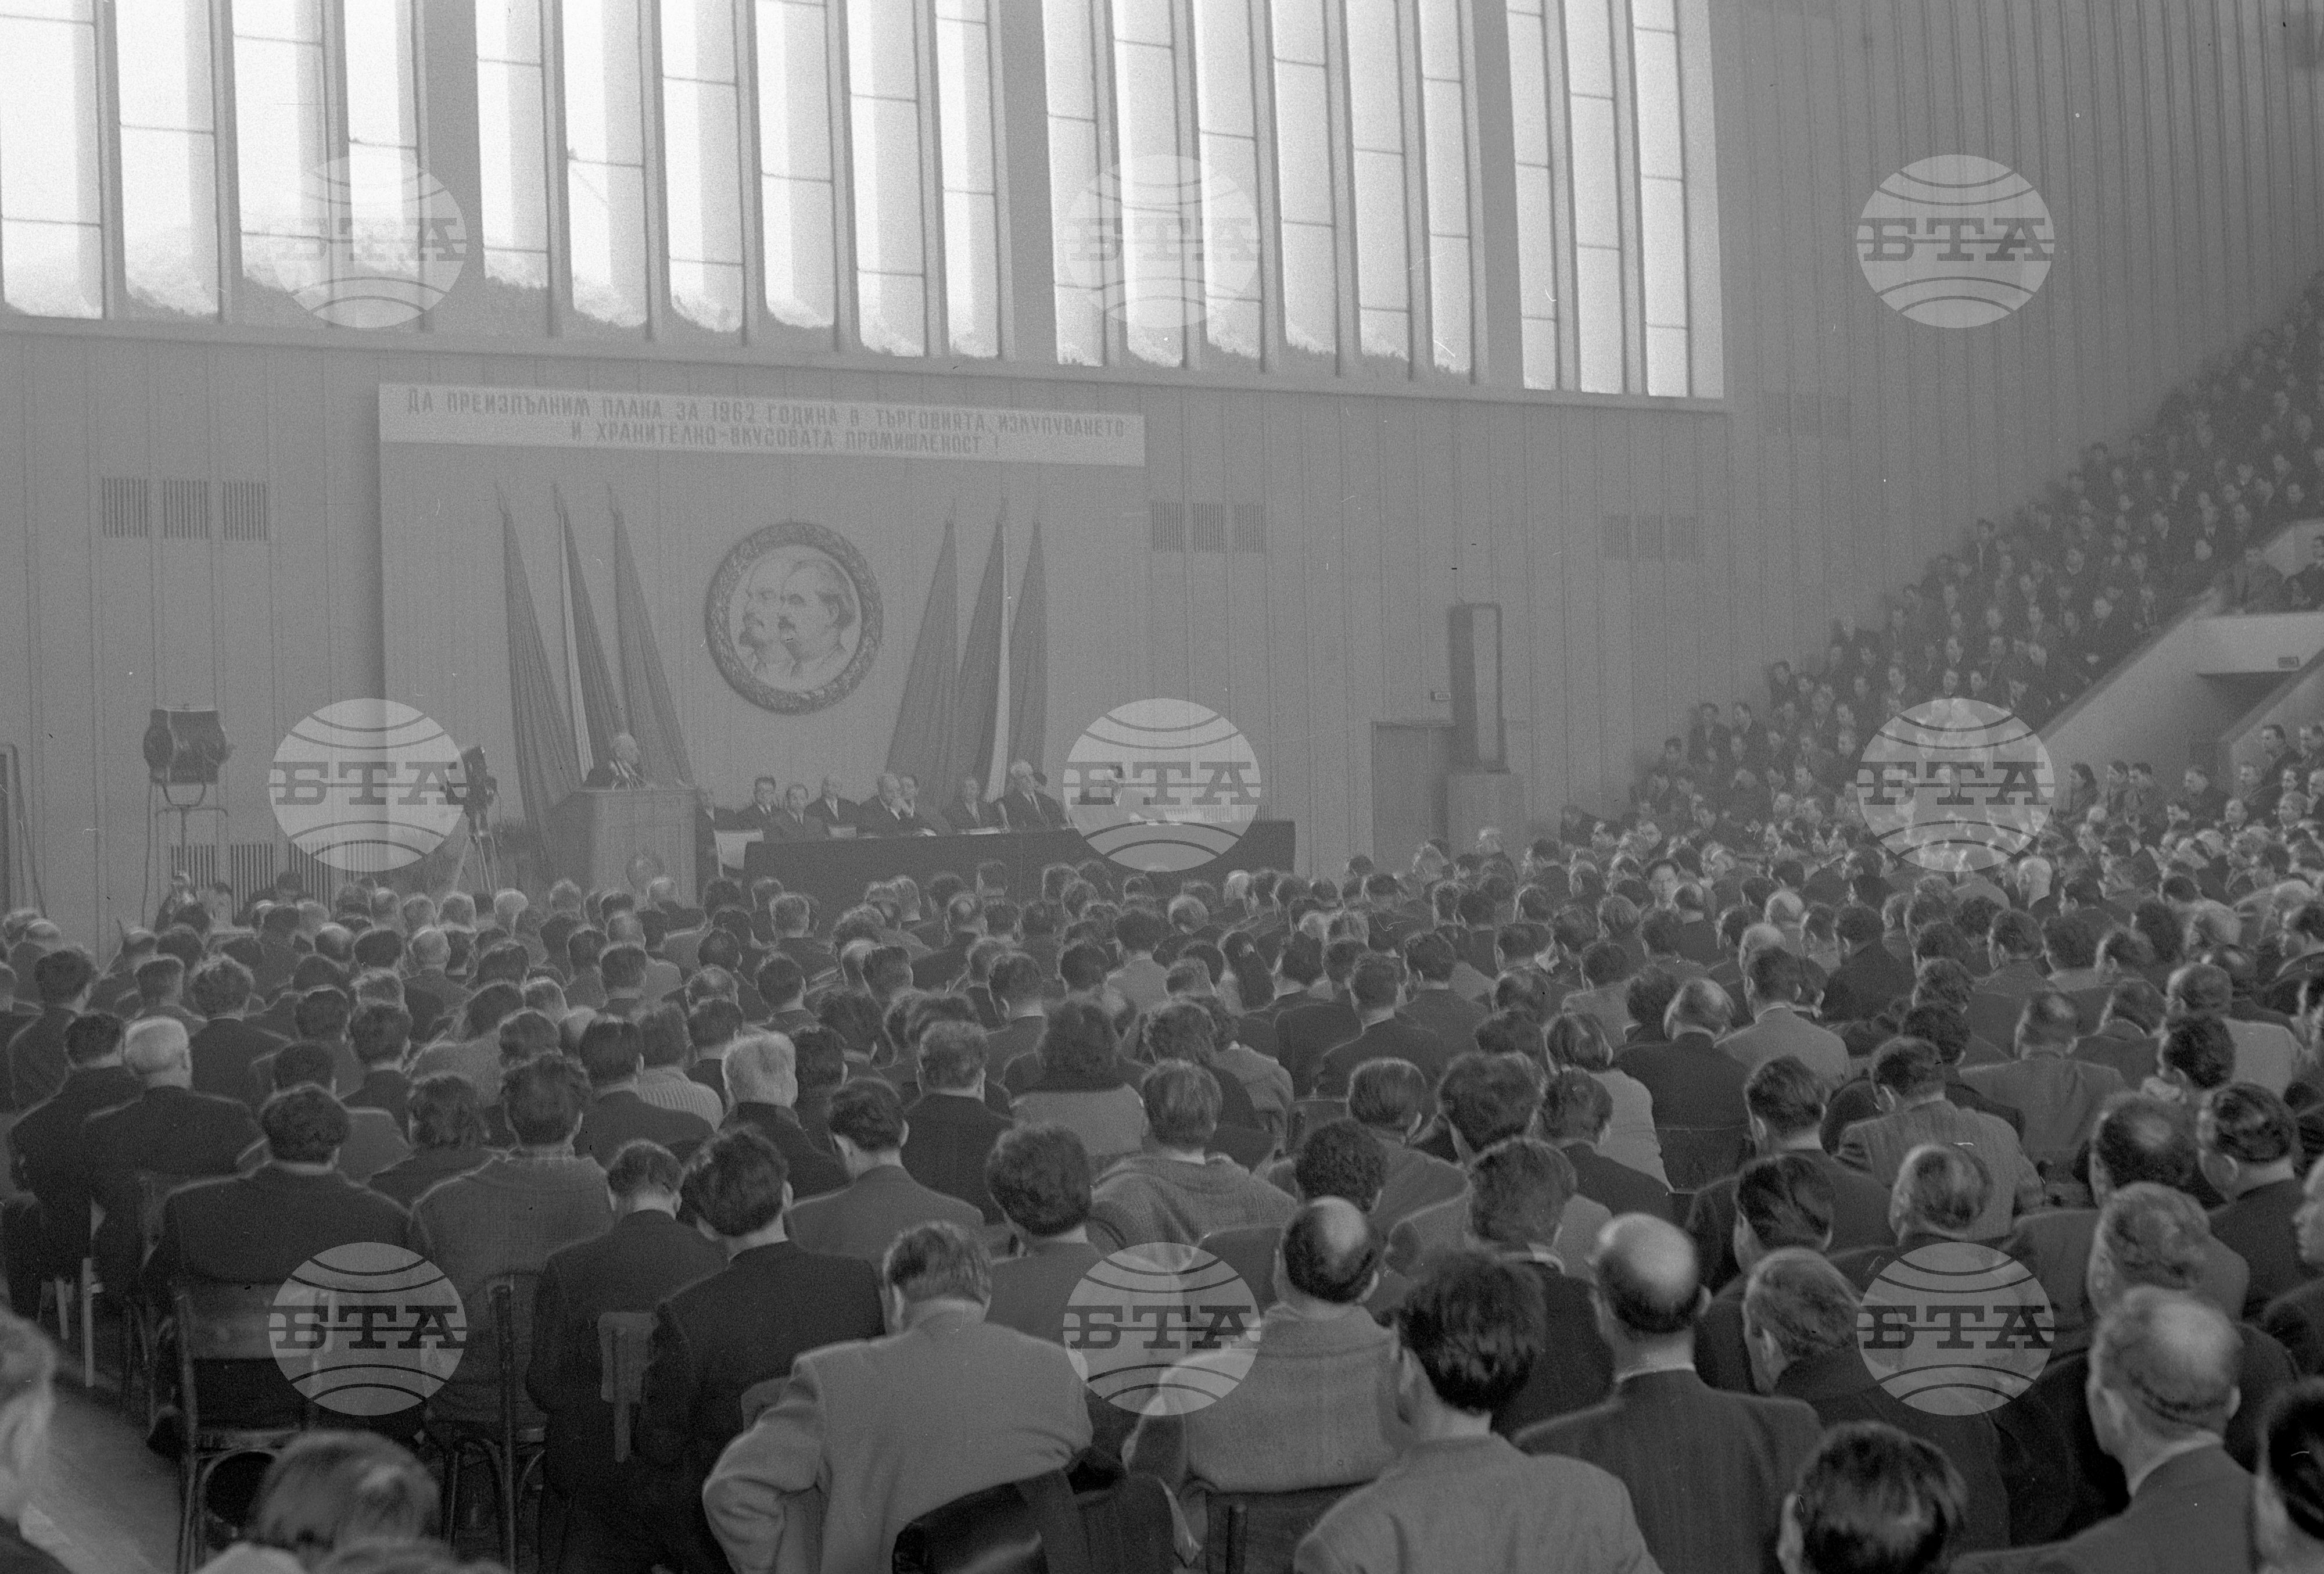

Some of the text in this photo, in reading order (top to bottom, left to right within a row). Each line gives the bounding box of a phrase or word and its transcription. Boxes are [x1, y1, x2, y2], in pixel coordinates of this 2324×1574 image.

[407, 387, 433, 414] ДА
[447, 392, 590, 416] ПРЕИЗПЪЛНИМ
[602, 397, 662, 418] ПЛАНА
[676, 401, 698, 421] ЗА
[712, 401, 754, 423] 1962
[768, 404, 837, 428] ГОДИНА
[850, 407, 859, 426] В
[999, 415, 1124, 438] ИЗКУПУВАНЕТО
[572, 420, 582, 440] И
[846, 431, 981, 454] ПРОМИШЛЕНОСТ
